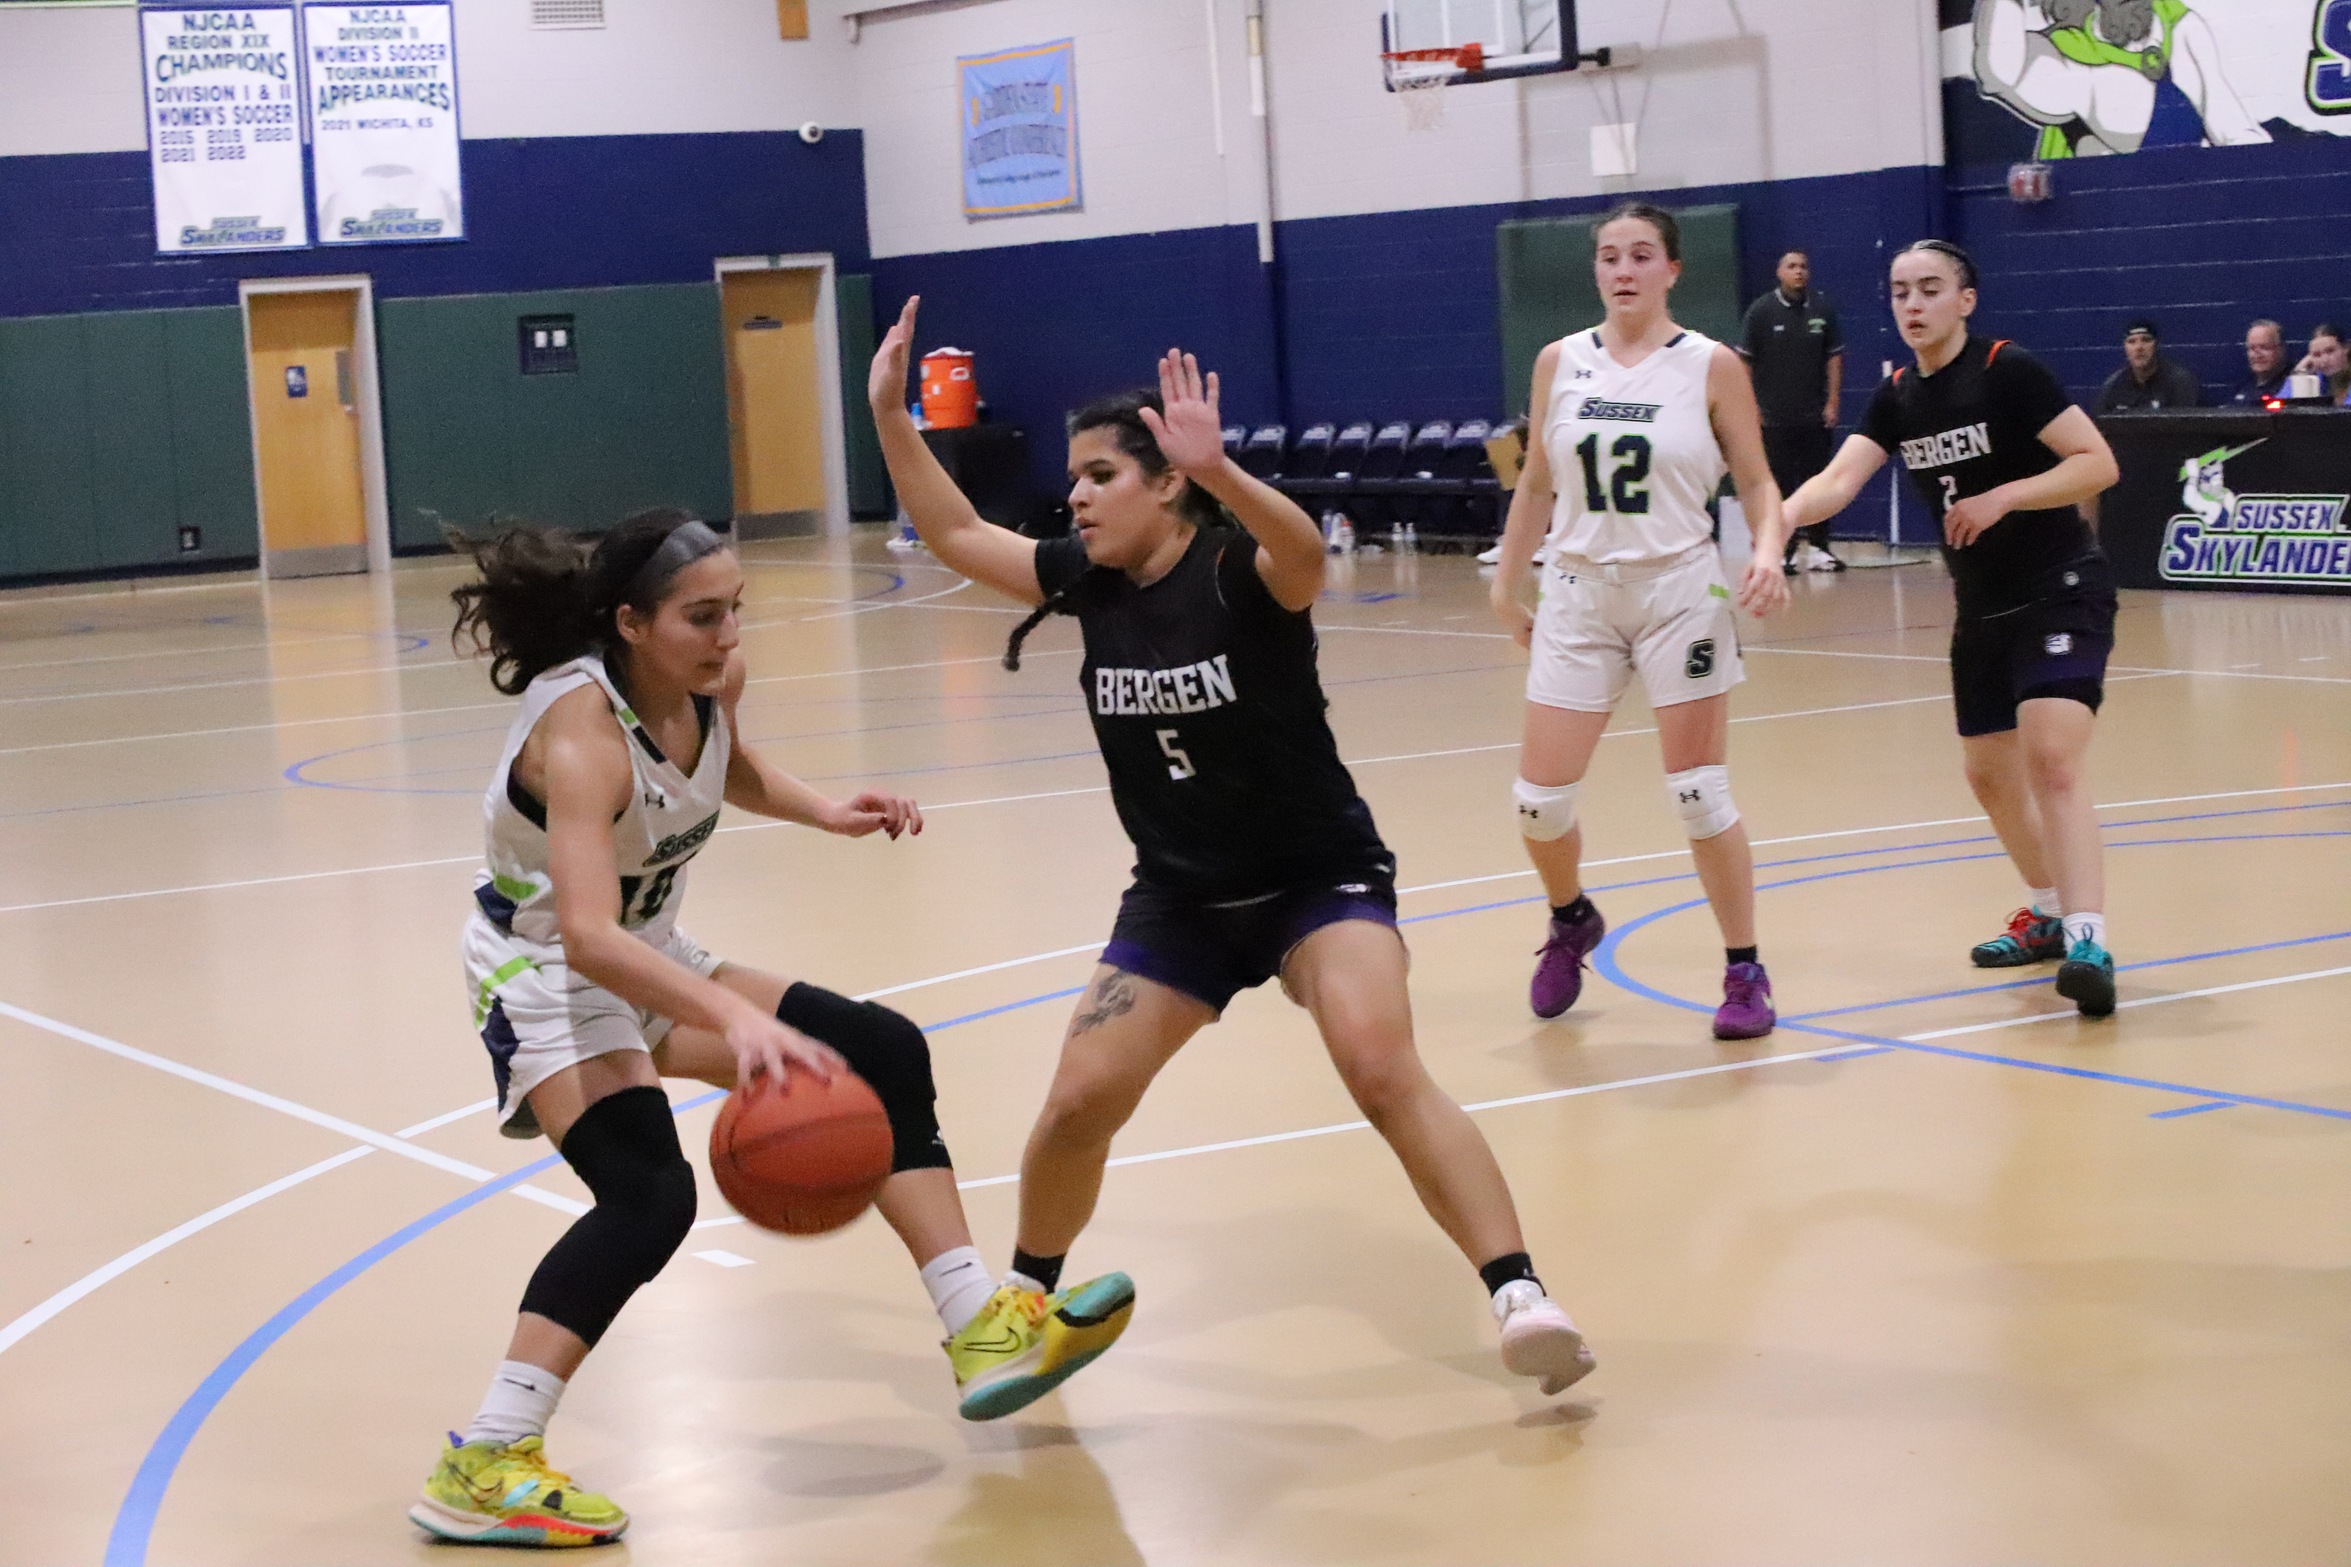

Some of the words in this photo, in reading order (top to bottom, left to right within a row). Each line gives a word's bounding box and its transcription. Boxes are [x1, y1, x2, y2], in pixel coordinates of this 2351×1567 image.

[183, 13, 256, 31] NJCAA
[350, 10, 406, 23] NJCAA
[167, 35, 232, 50] REGION
[241, 34, 270, 48] XIX
[338, 27, 402, 40] DIVISION
[409, 26, 419, 39] II
[314, 46, 381, 62] WOMEN'S
[389, 44, 447, 61] SOCCER
[156, 53, 288, 82] CHAMPIONS
[326, 65, 438, 81] TOURNAMENT
[155, 86, 236, 102] DIVISION
[259, 84, 270, 100] &
[280, 84, 291, 100] II
[318, 83, 450, 115] APPEARANCES
[156, 106, 226, 126] WOMEN'S
[233, 104, 294, 125] SOCCER
[418, 116, 434, 128] KS
[254, 127, 293, 142] 2020
[207, 145, 246, 160] 2022
[1580, 399, 1656, 421] SUSSEX
[1576, 433, 1651, 514] 12
[2237, 503, 2335, 531] SUSSEX
[2168, 525, 2351, 575] SKYLANDE
[1688, 641, 1714, 676] S
[1095, 654, 1237, 715] BERGEN
[1155, 729, 1197, 780] 5
